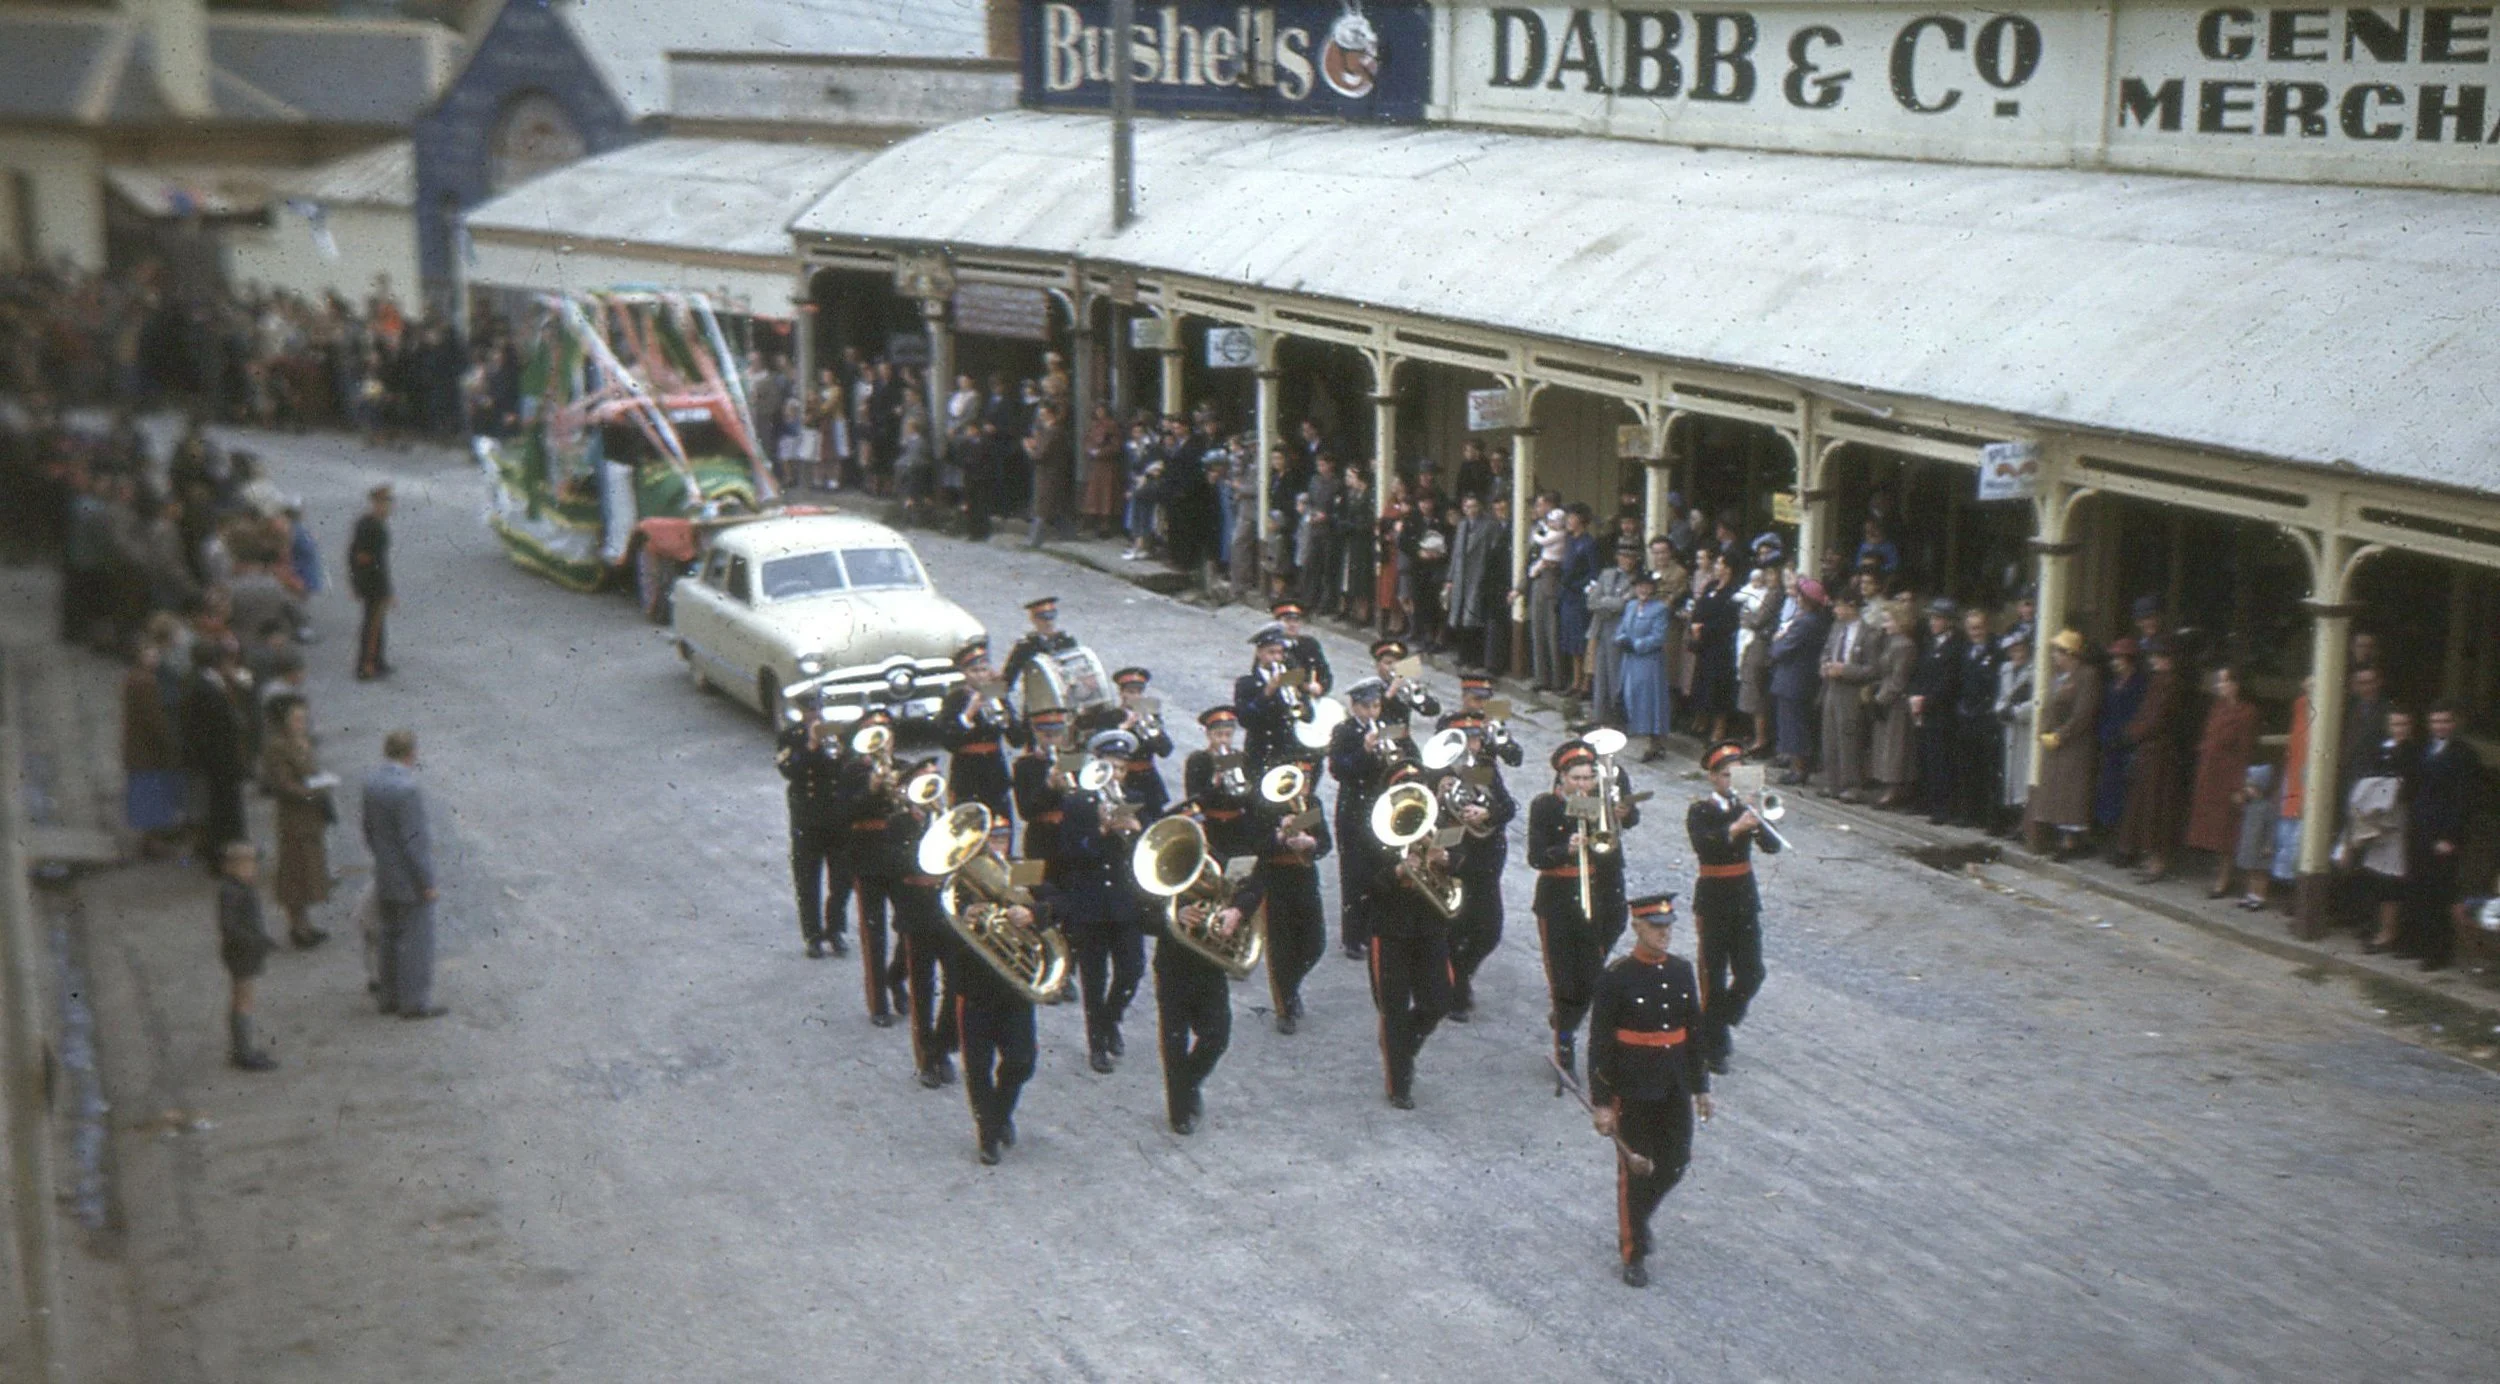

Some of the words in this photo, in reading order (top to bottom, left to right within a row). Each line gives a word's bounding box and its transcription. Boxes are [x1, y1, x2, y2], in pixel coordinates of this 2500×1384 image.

[1043, 3, 1314, 100] Bushells
[1489, 8, 1758, 102] DABB
[1783, 24, 1852, 110] &
[2197, 7, 2494, 64] GENE
[2118, 77, 2500, 144] MERCH
